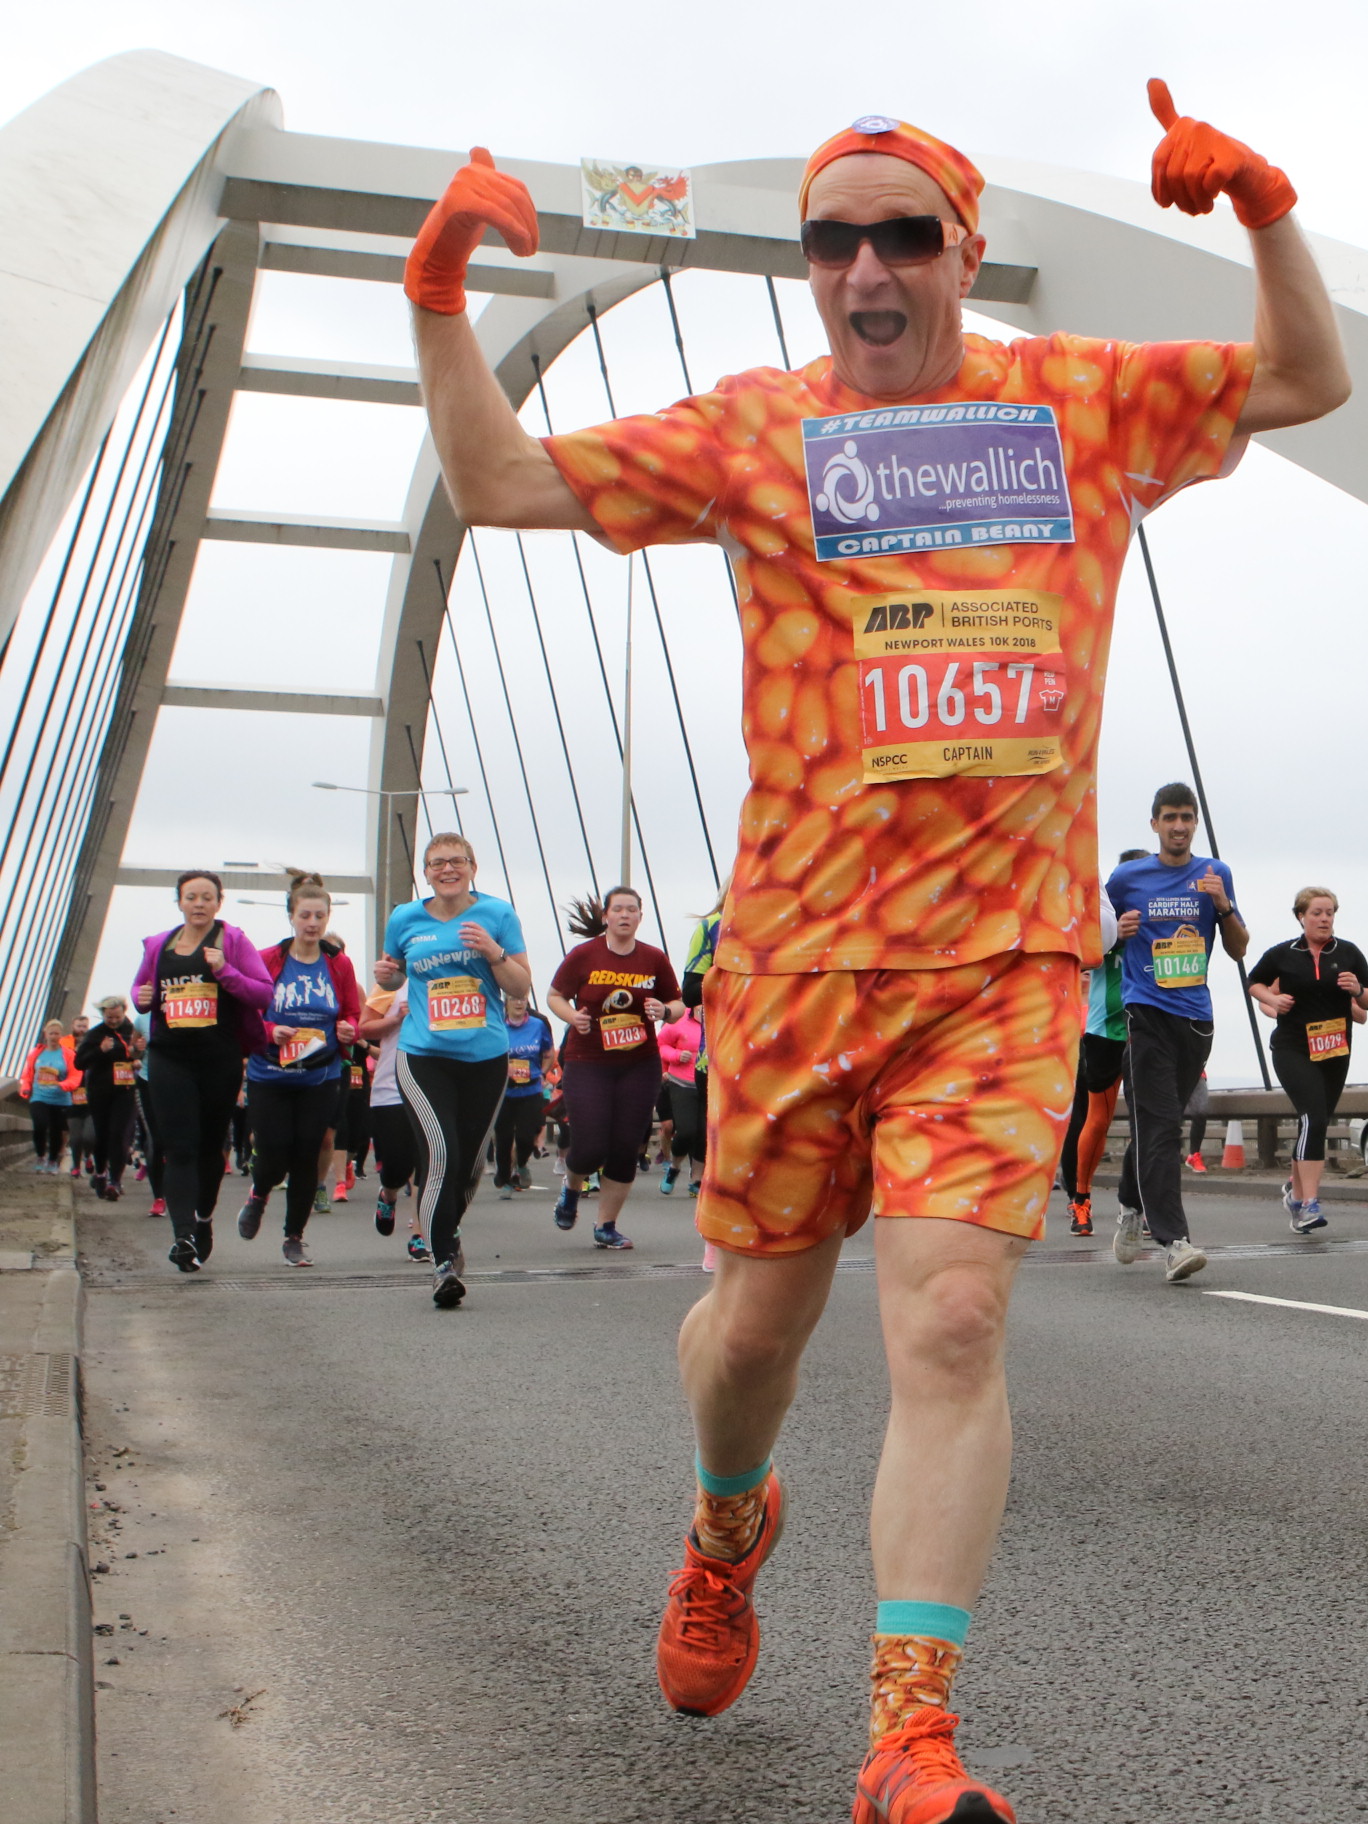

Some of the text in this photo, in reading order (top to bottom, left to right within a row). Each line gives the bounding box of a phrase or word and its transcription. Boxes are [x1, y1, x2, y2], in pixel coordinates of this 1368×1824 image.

[820, 405, 1038, 434] #TEAMWALLICH
[877, 447, 1057, 500] thewallich
[998, 493, 1060, 505] homelessness
[837, 524, 1054, 555] CAPTAIN BEANY
[951, 601, 1038, 614] ASSOCIATED
[863, 603, 934, 634] ABP
[951, 616, 1053, 631] BRITISH PORTS
[885, 637, 1036, 650] NEWPORT WALES 10K 2018
[864, 662, 1034, 732] 10657
[872, 754, 908, 768] NSPCC
[943, 746, 993, 763] CAPTAIN
[1148, 900, 1200, 909] CARDIFF HALF
[1148, 908, 1200, 917] MARATHON
[1155, 956, 1199, 976] 10146
[588, 970, 656, 989] REDSKINS
[168, 1000, 210, 1017] 11499
[431, 996, 480, 1018] 10268
[603, 1026, 641, 1046] 11203
[1310, 1033, 1342, 1052] 10629
